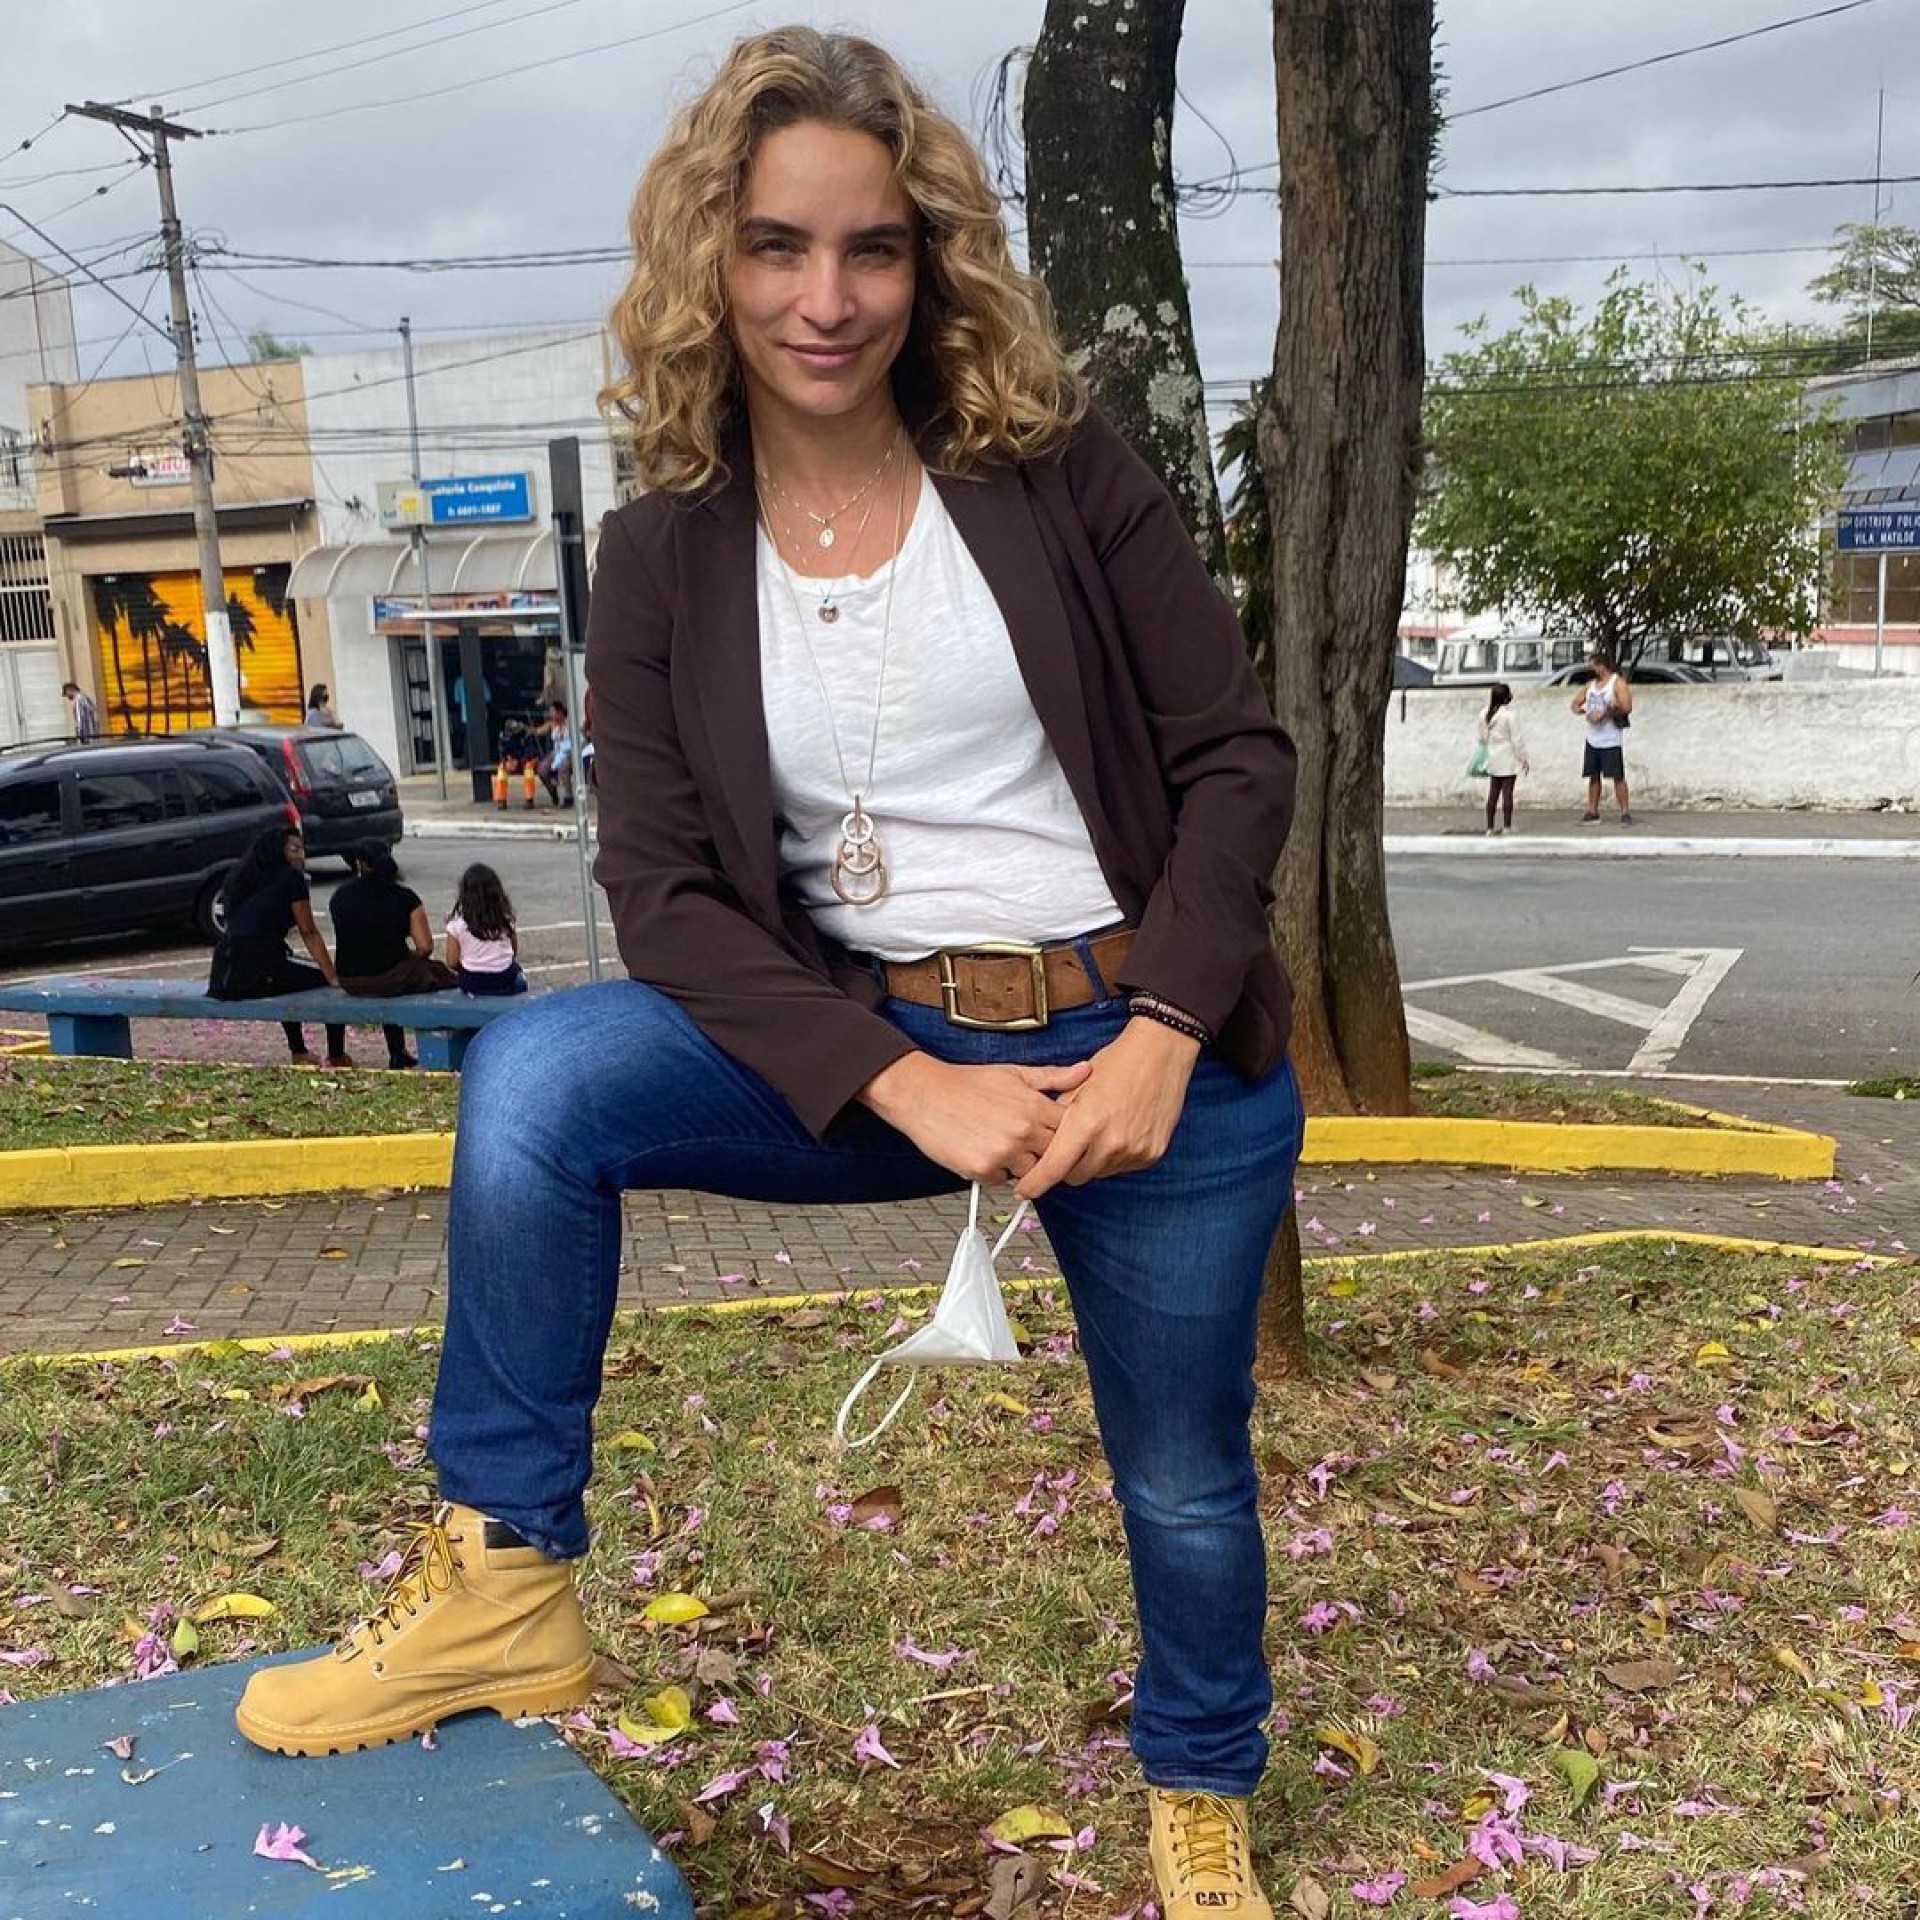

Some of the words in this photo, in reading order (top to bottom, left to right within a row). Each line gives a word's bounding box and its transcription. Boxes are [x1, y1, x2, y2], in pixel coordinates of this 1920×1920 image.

[1854, 514, 1893, 529] DISTRITO
[1855, 531, 1874, 545] VILA
[1880, 531, 1915, 544] MATILDE
[1195, 1891, 1232, 1906] CAT
